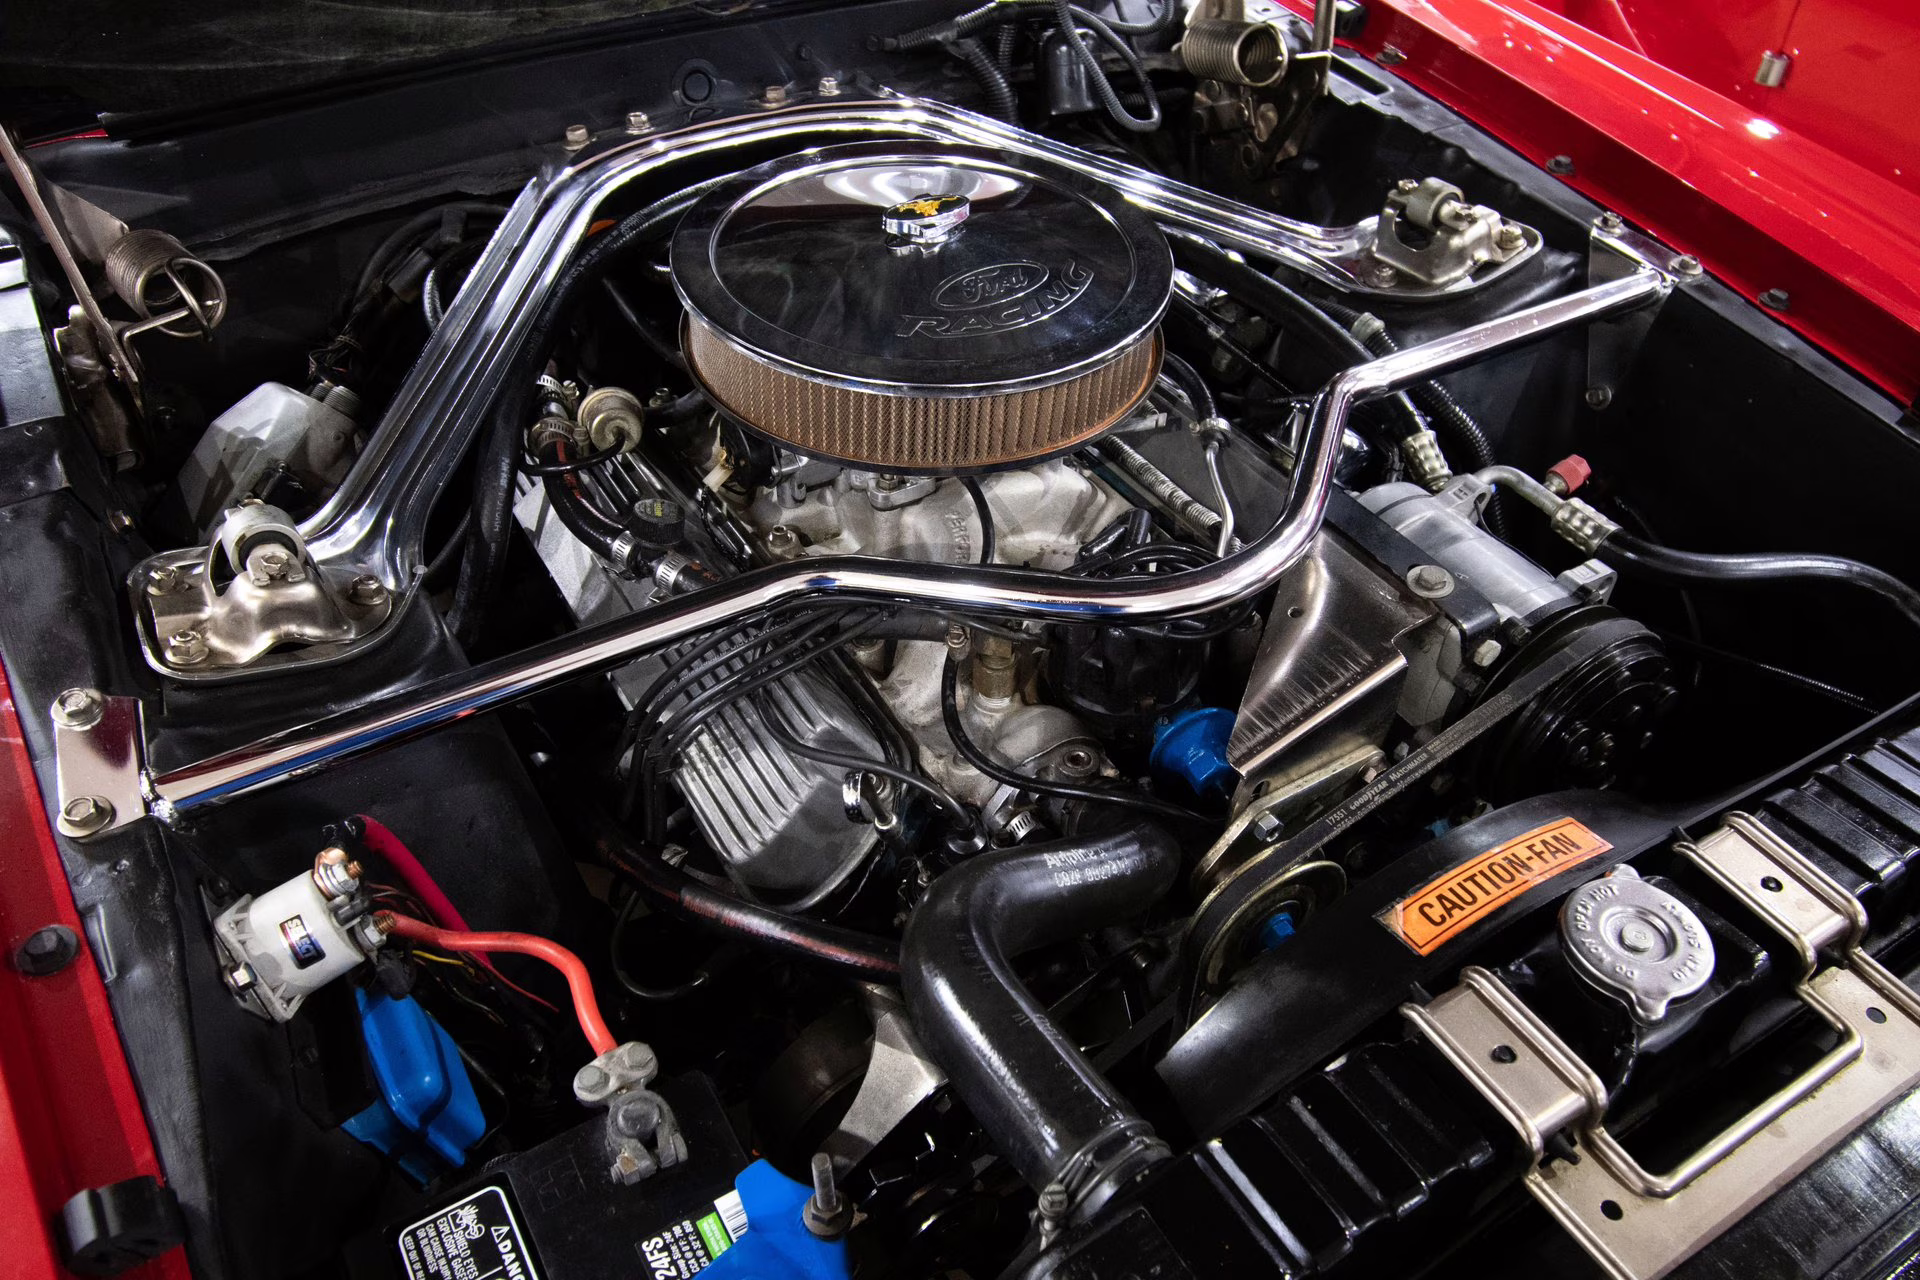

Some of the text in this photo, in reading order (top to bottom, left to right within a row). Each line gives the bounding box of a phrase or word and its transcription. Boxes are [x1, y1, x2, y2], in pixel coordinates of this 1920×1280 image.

[961, 267, 1029, 304] Ford
[896, 258, 1095, 338] RACING
[1324, 808, 1348, 826] 17551
[1350, 780, 1389, 811] GOODYEAR
[1418, 832, 1583, 927] CAUTION-FAN
[1574, 897, 1597, 932] OPEN
[1589, 883, 1621, 902] HOT
[425, 1222, 438, 1240] CAN
[661, 1230, 675, 1245] 24F
[671, 1224, 684, 1239] 700
[681, 1219, 695, 1234] 850
[403, 1234, 414, 1252] KEEP
[428, 1236, 446, 1261] CAUSE
[436, 1217, 460, 1259] EXPLOSIVE
[407, 1250, 418, 1264] OUT
[415, 1228, 440, 1274] OR BLINDNESS
[453, 1230, 480, 1280] SHIELD EYES
[698, 1255, 711, 1268] CA
[411, 1260, 422, 1271] OF
[676, 1258, 691, 1280] Group
[687, 1257, 701, 1274] CCA
